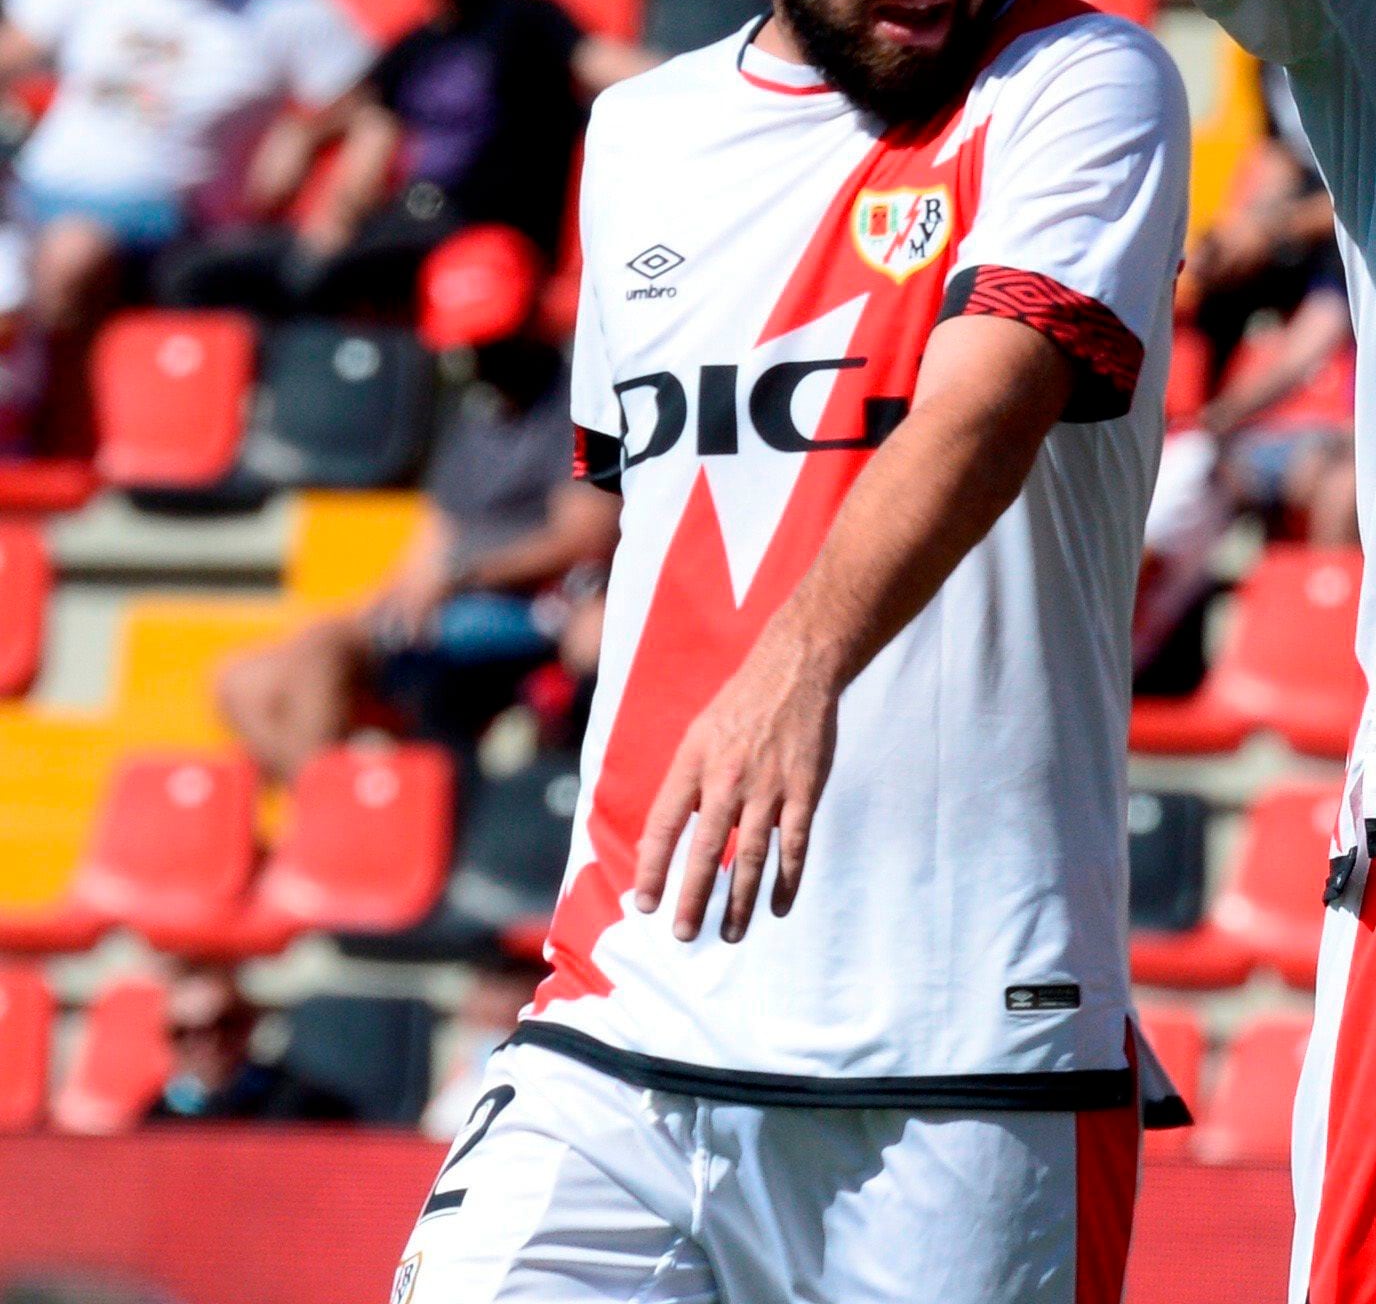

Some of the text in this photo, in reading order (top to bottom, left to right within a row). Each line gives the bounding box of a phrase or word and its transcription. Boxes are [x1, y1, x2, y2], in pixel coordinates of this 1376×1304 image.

[625, 283, 677, 301] umbro
[612, 356, 923, 468] DIG
[420, 1083, 517, 1225] 2
